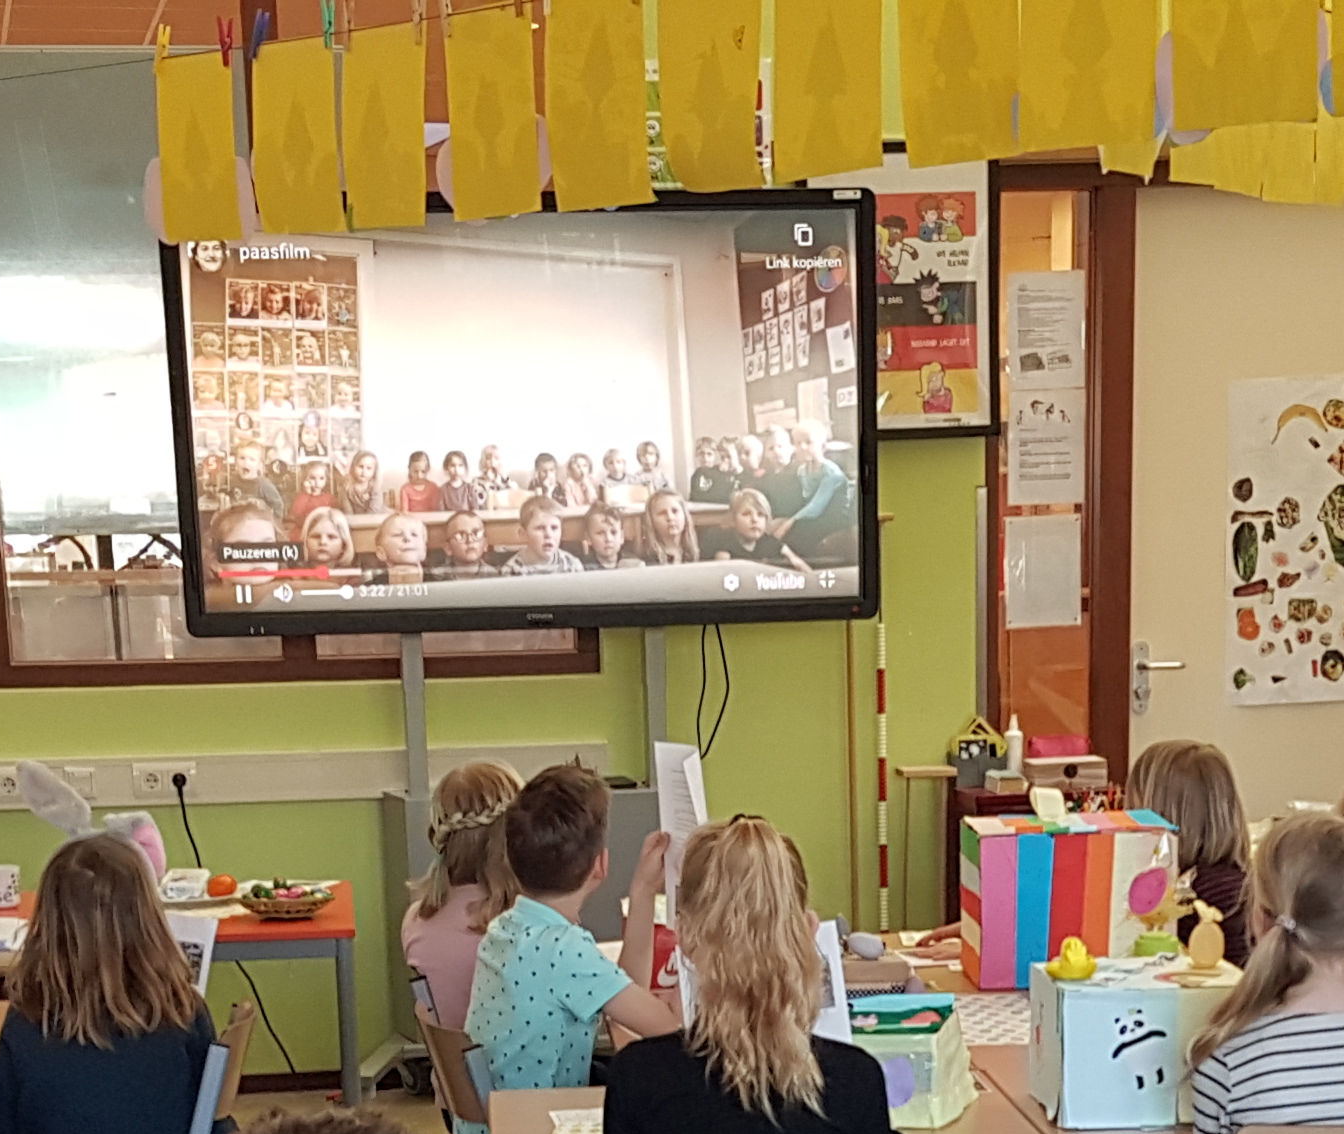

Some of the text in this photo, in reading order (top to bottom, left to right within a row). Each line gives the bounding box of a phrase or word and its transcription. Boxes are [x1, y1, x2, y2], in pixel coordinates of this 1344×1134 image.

[239, 242, 311, 264] paasfilm
[766, 255, 843, 270] Link kopiëren
[223, 545, 299, 561] Pauzeren (k)
[756, 572, 805, 591] YouTube
[359, 585, 385, 598] 3:22
[396, 583, 429, 597] 21:01
